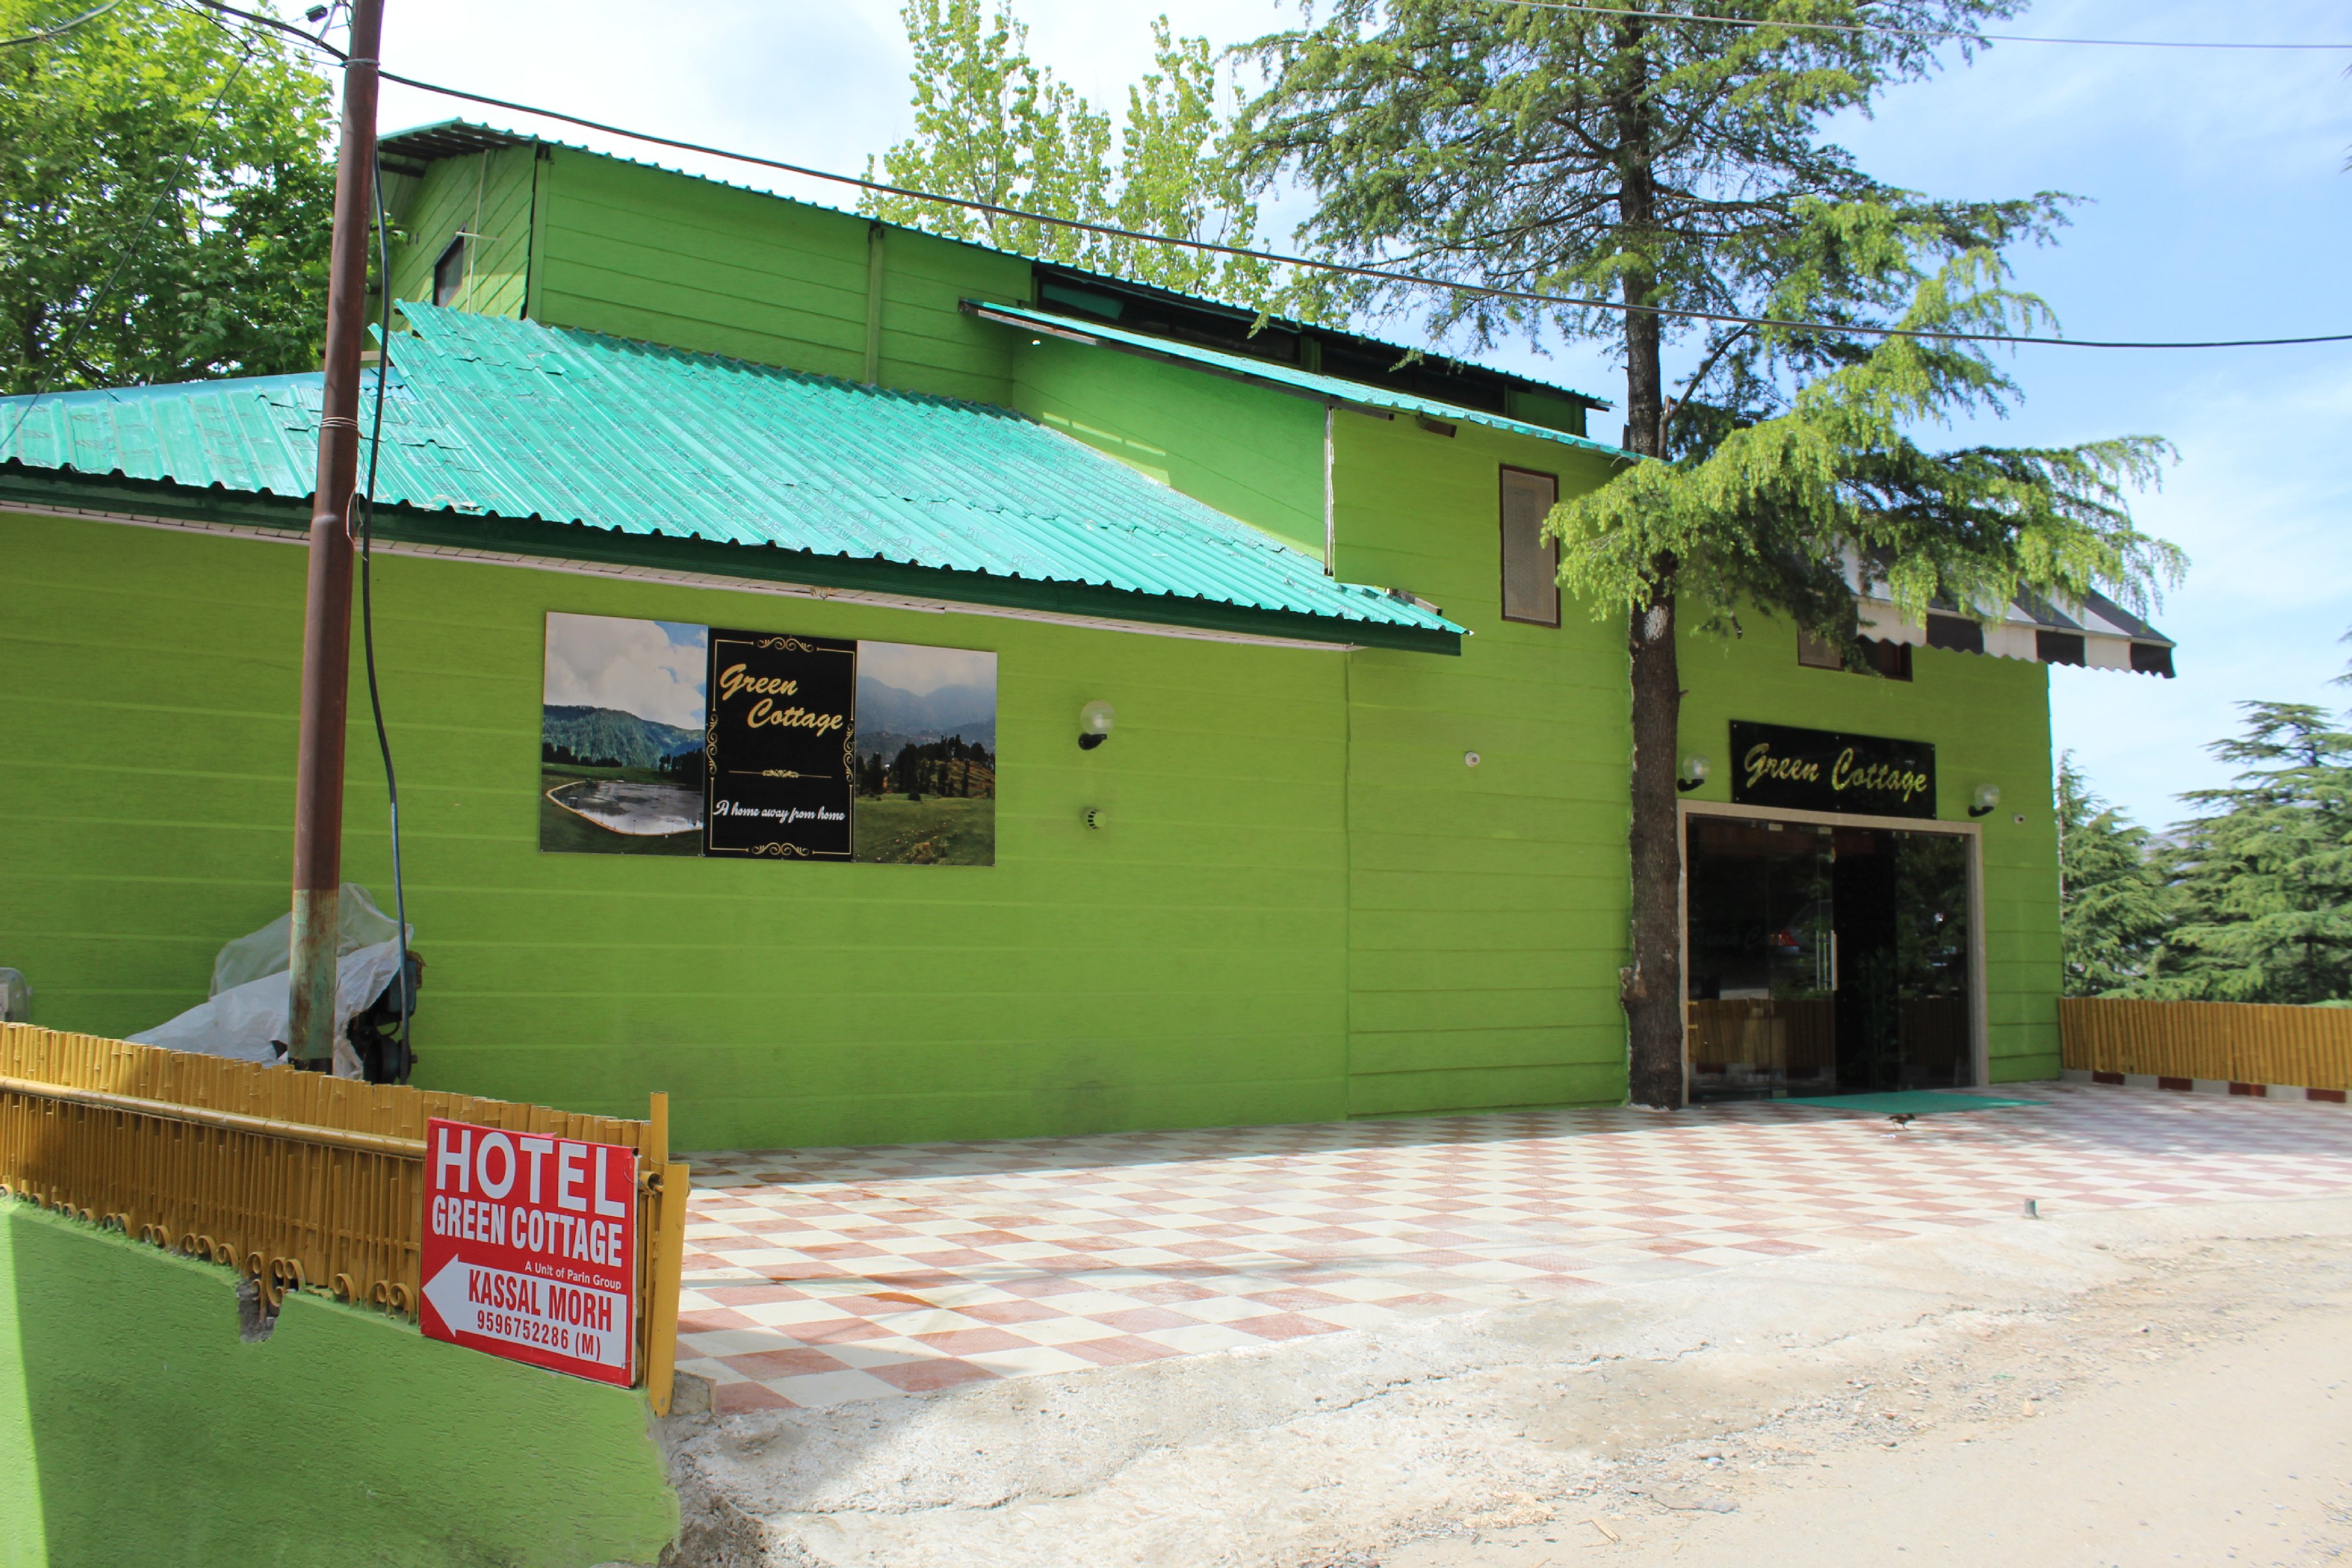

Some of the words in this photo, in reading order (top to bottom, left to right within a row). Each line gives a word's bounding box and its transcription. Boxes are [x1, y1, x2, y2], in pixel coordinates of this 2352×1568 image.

[720, 663, 798, 701] Green
[747, 698, 843, 737] Cottage
[1744, 743, 1819, 788] Green
[1831, 747, 1927, 802] Cottage
[712, 799, 730, 816] A
[731, 801, 760, 817] home
[760, 807, 789, 824] away
[787, 807, 816, 823] from
[817, 806, 846, 821] home
[436, 1128, 626, 1219] HOTEL
[432, 1195, 506, 1245] GREEN
[512, 1206, 622, 1268] COTTAGE
[468, 1269, 541, 1316] KASSAL
[548, 1285, 612, 1333] MORH
[524, 1261, 532, 1272] A
[535, 1262, 554, 1276] Unit
[556, 1267, 565, 1279] of
[567, 1269, 591, 1284] Parin
[593, 1274, 622, 1291] Group
[477, 1309, 569, 1350] 9596752286
[575, 1332, 601, 1362] (M)
